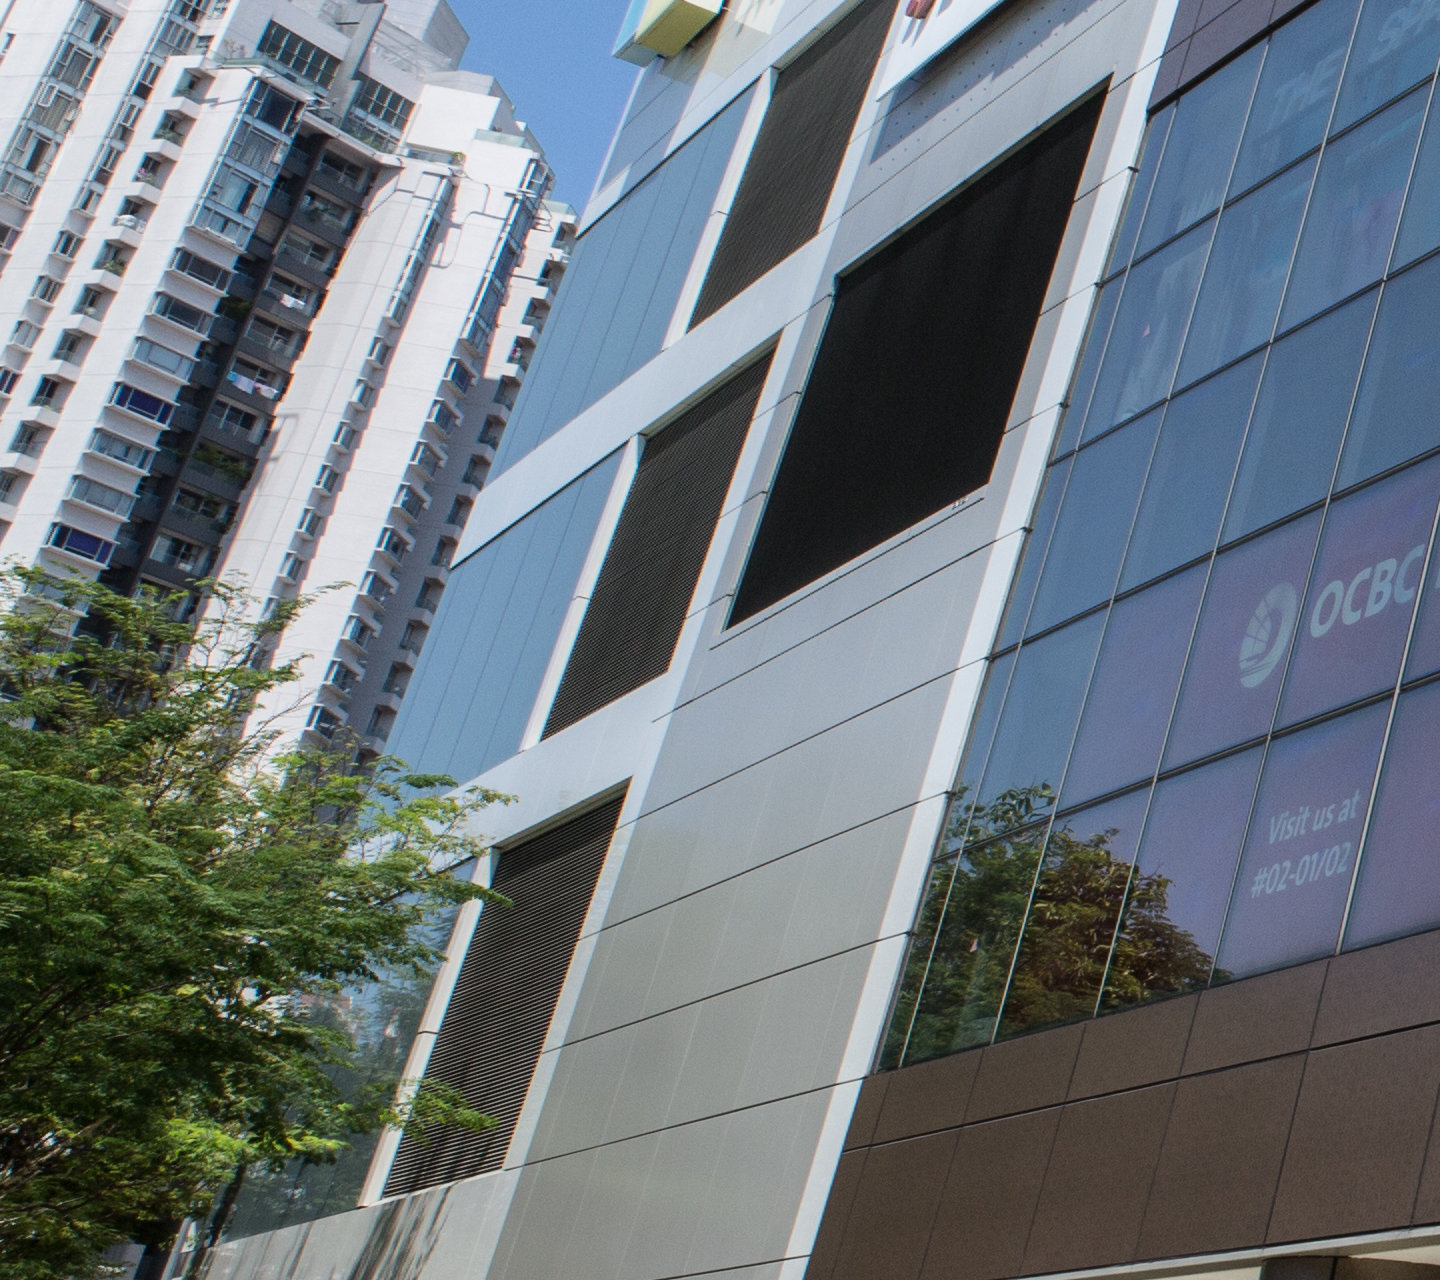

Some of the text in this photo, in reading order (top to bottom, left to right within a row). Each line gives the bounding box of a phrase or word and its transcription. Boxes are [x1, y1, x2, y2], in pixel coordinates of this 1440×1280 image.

[1310, 545, 1427, 639] OCBC
[1268, 788, 1362, 845] Visit us at
[1251, 842, 1349, 898] #02-01/02
